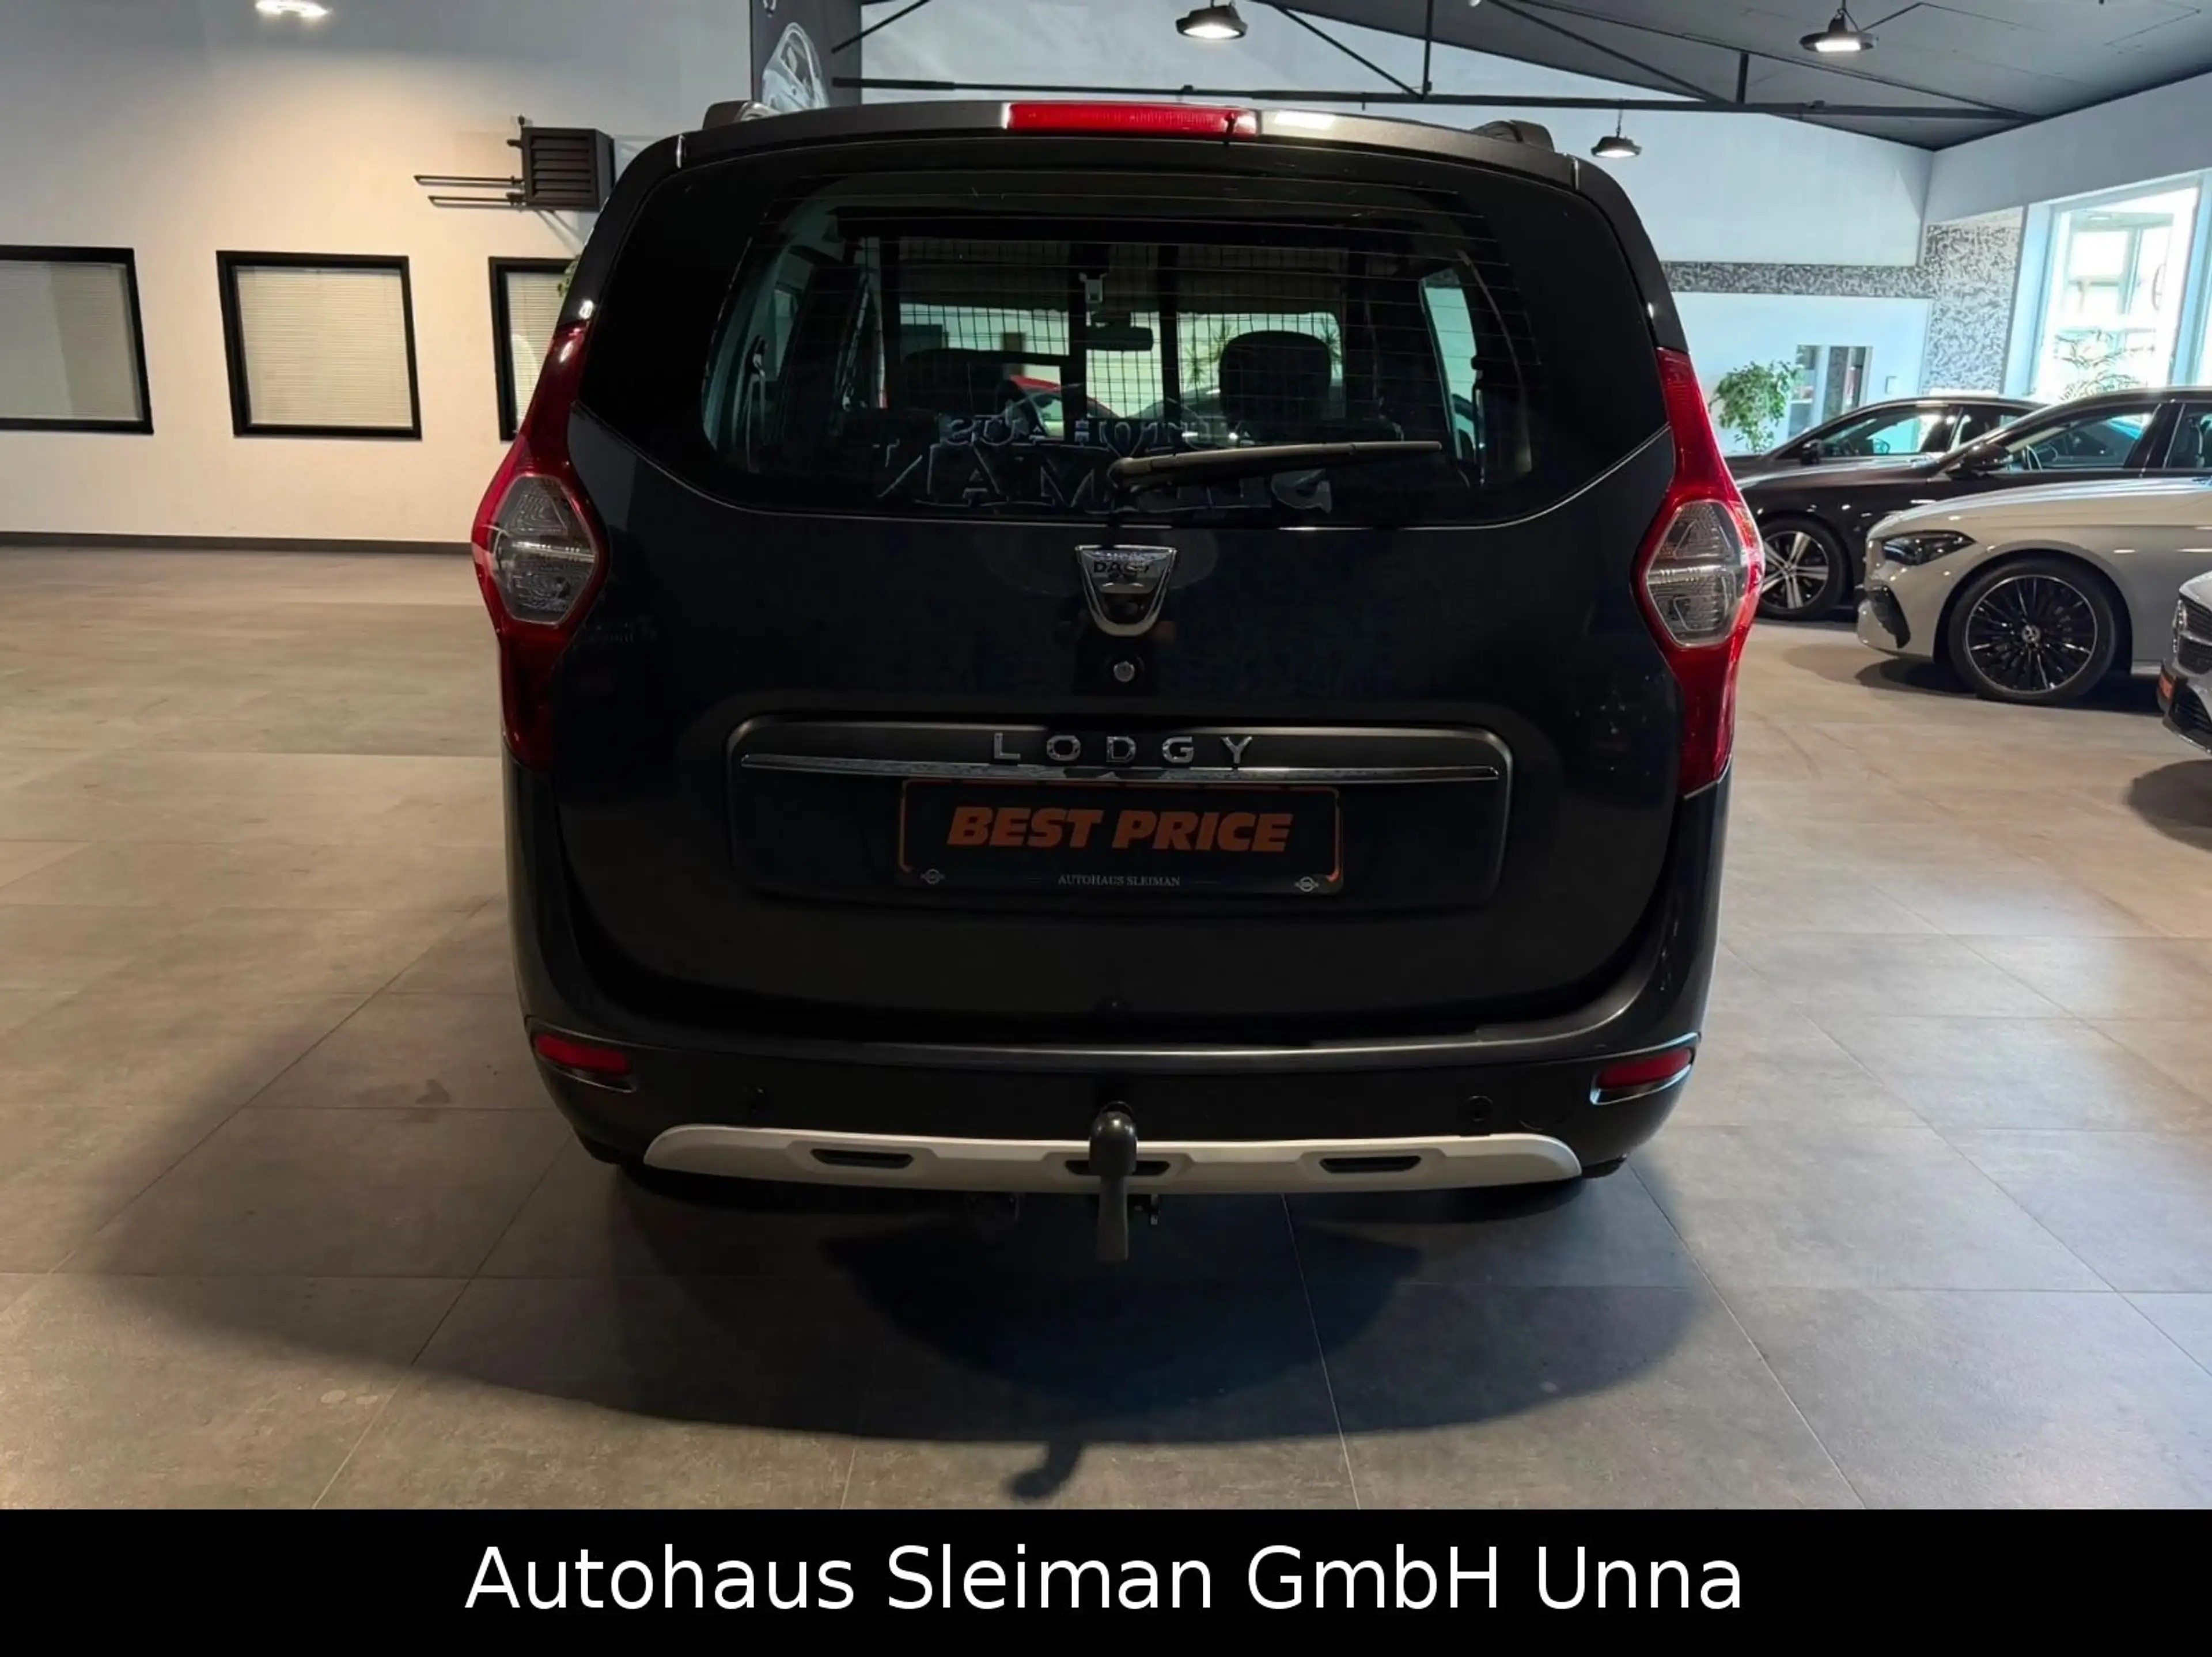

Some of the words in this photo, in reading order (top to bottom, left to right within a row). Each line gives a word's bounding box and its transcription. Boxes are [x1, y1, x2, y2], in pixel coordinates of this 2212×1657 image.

[1093, 561, 1154, 574] DAC
[993, 731, 1253, 765] LODGY
[948, 807, 1103, 849] BEST
[1112, 809, 1293, 852] PRICE
[1058, 873, 1124, 886] AUTOHAUS
[1126, 874, 1181, 888] SLEIMAN
